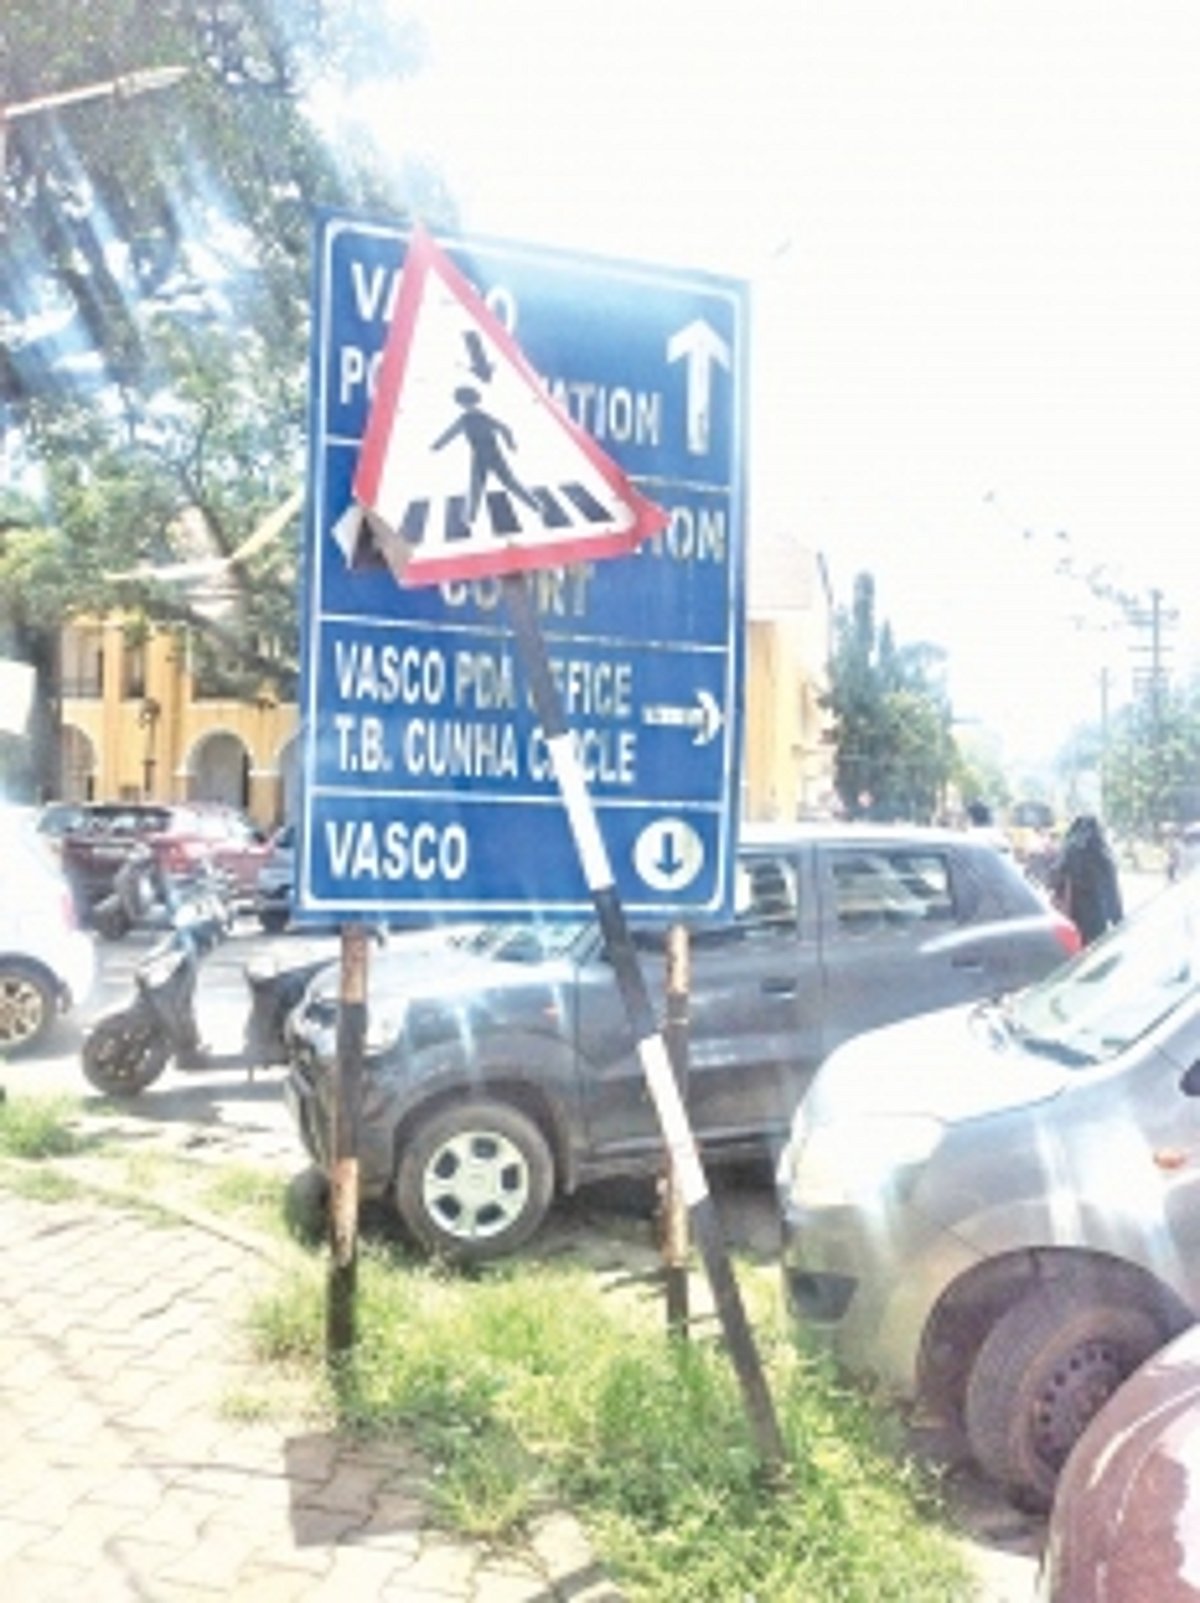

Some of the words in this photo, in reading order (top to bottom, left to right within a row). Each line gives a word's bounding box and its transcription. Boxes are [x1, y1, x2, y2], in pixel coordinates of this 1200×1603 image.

[334, 640, 446, 705] VASCO
[526, 659, 633, 719] FFICE
[334, 712, 394, 773] T.B.
[403, 717, 520, 780] CUNHA
[324, 820, 469, 880] VASCO
